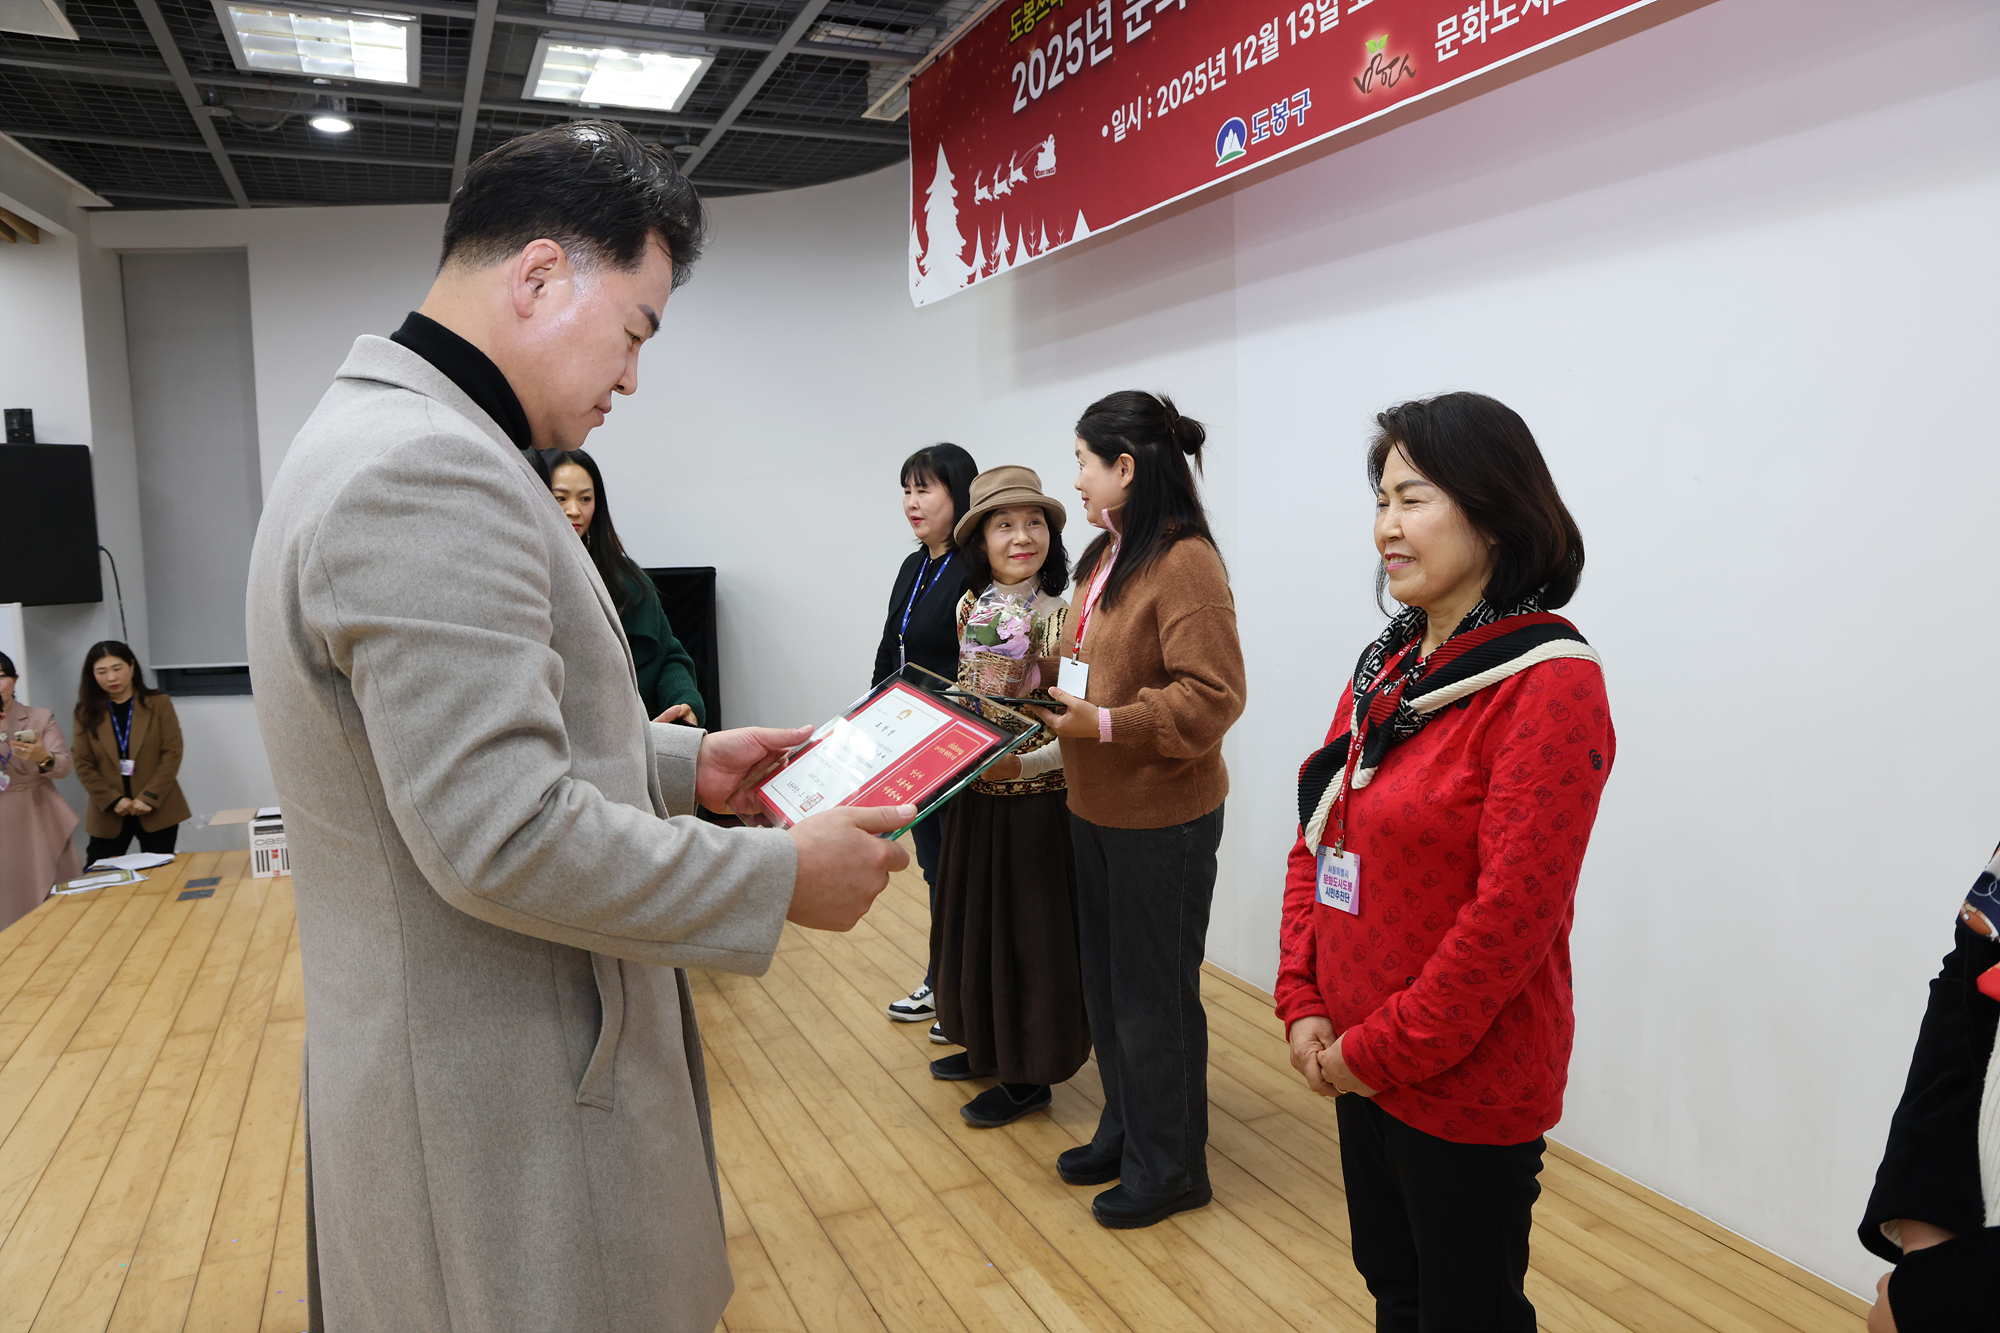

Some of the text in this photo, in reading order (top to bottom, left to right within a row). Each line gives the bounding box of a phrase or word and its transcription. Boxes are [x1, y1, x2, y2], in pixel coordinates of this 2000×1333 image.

[1011, 0, 1187, 114] 2025년 문
[1434, 0, 1568, 63] 문화도
[1111, 95, 1142, 143] 일시
[1156, 47, 1227, 118] 2025년
[1232, 17, 1280, 75] 12월
[1286, 0, 1340, 47] 13일
[1251, 88, 1312, 145] 도봉구
[1323, 873, 1353, 893] 문화도시도봉
[1324, 886, 1351, 904] 시민추진단
